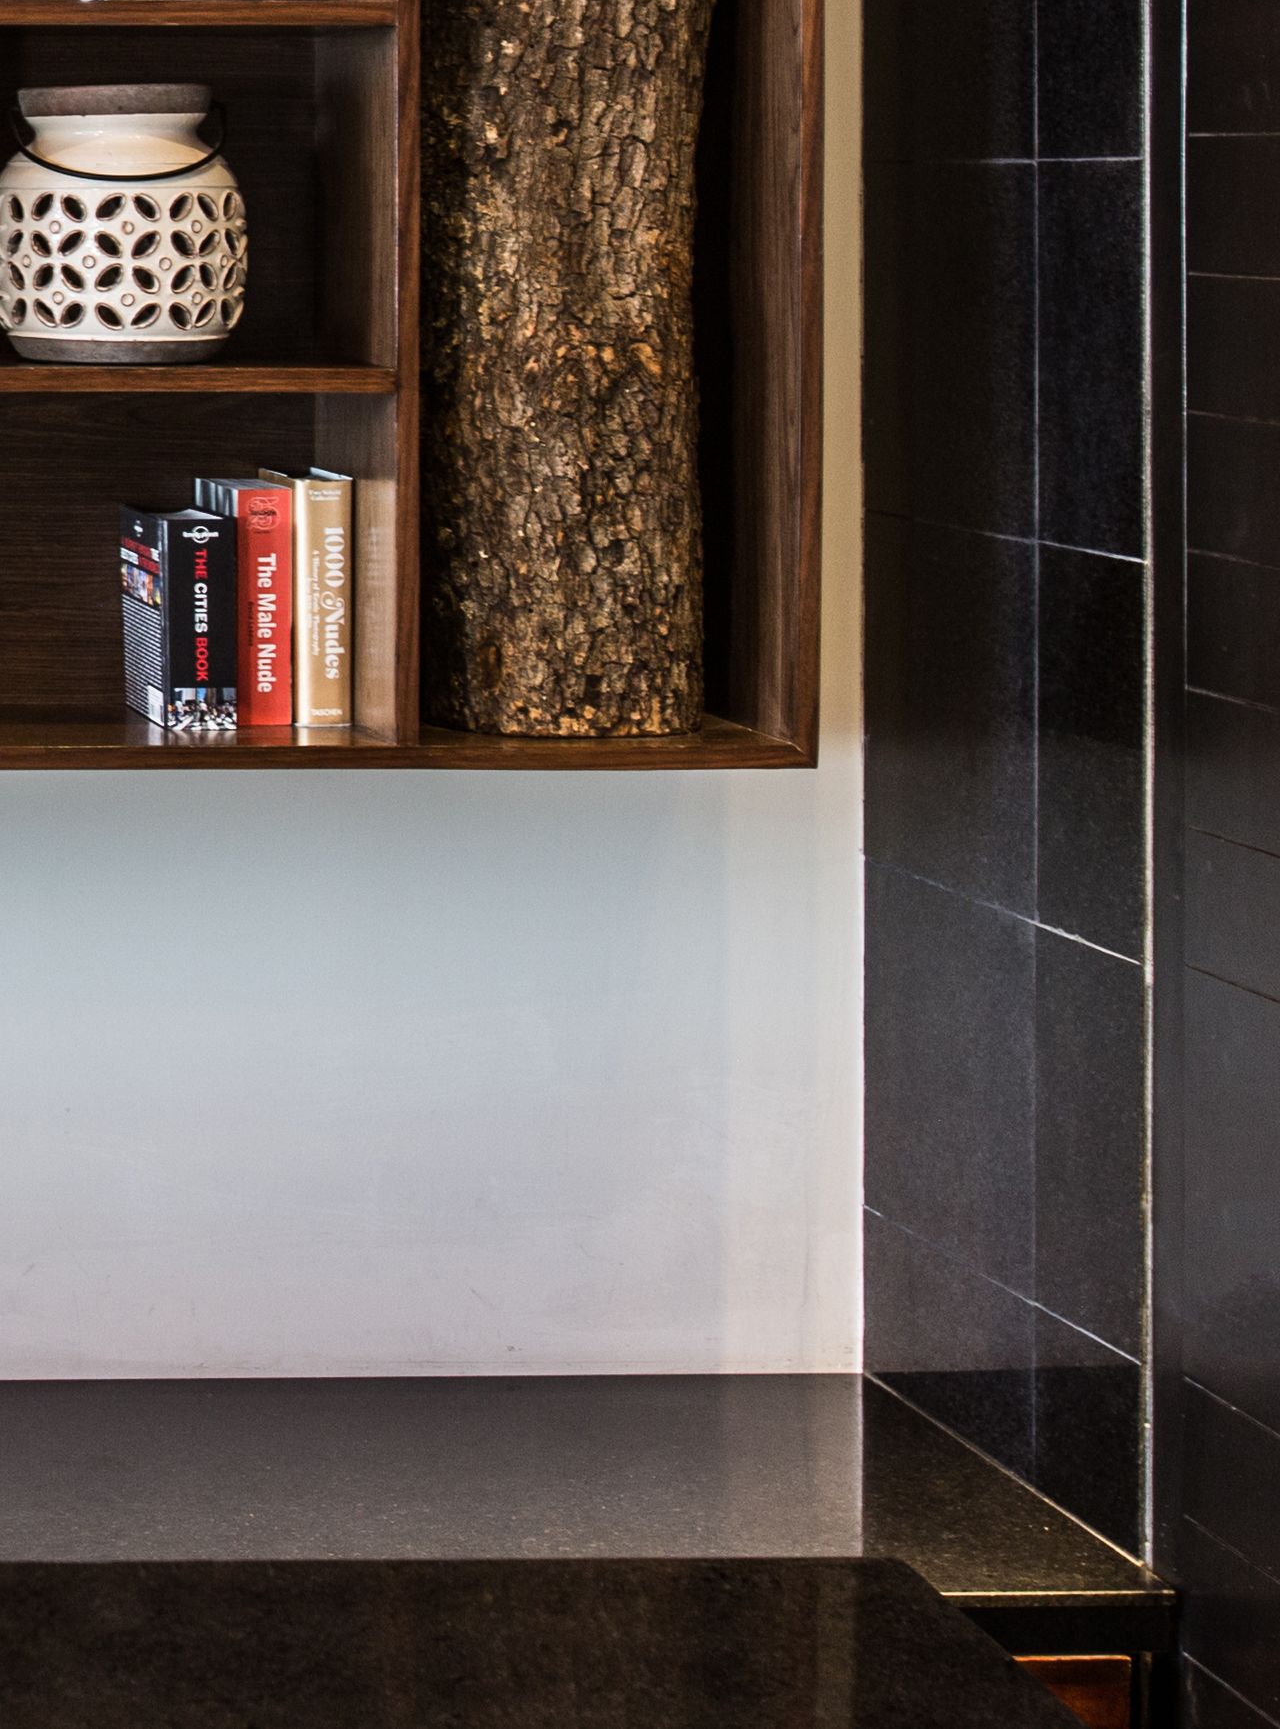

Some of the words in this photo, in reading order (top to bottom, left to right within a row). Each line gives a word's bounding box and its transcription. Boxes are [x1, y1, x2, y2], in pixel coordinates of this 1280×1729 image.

[194, 548, 208, 578] THE
[257, 553, 277, 588] The
[322, 526, 346, 588] 1000
[194, 582, 209, 633] CITIES
[257, 593, 277, 638] Male
[194, 636, 209, 681] BOOK
[320, 591, 346, 679] Nudes
[257, 643, 277, 693] Nude
